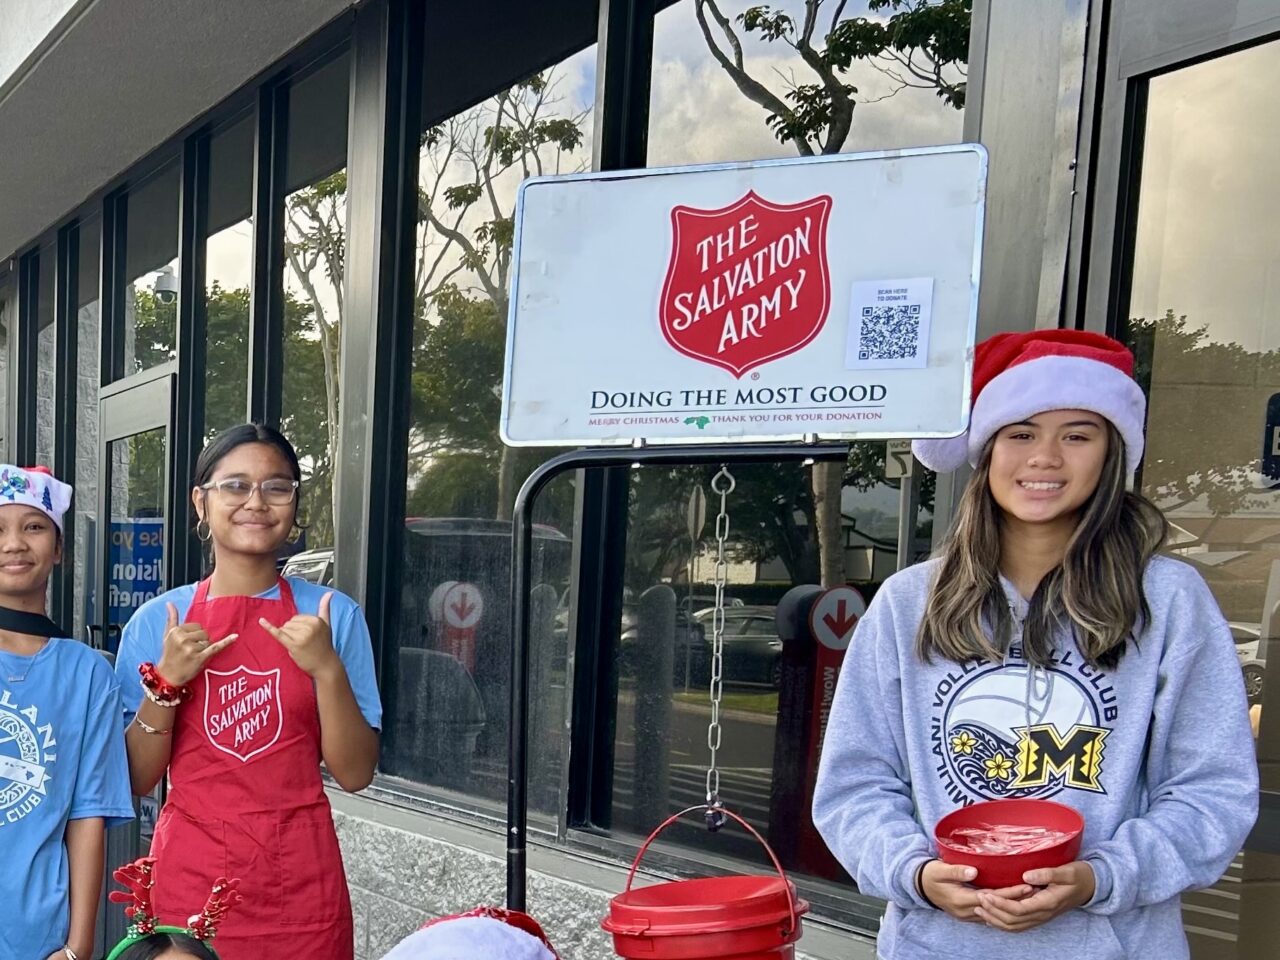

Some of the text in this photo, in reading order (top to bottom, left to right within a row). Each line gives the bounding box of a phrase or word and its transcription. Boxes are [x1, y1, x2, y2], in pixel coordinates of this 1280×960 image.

[696, 214, 759, 273] THE
[672, 216, 811, 331] SALVATION
[717, 268, 806, 354] ARMY
[588, 411, 882, 426] MERRY CHRISTMAS THANK YOU FOR YOUR DONATION
[590, 384, 887, 409] DOING THE MOST GOOD
[210, 679, 272, 735] SALVATION
[218, 676, 247, 705] THE
[1078, 662, 1118, 722] CLUB
[234, 705, 270, 748] ARMY
[931, 717, 975, 807] MILILANI
[6, 793, 42, 823] CLUB
